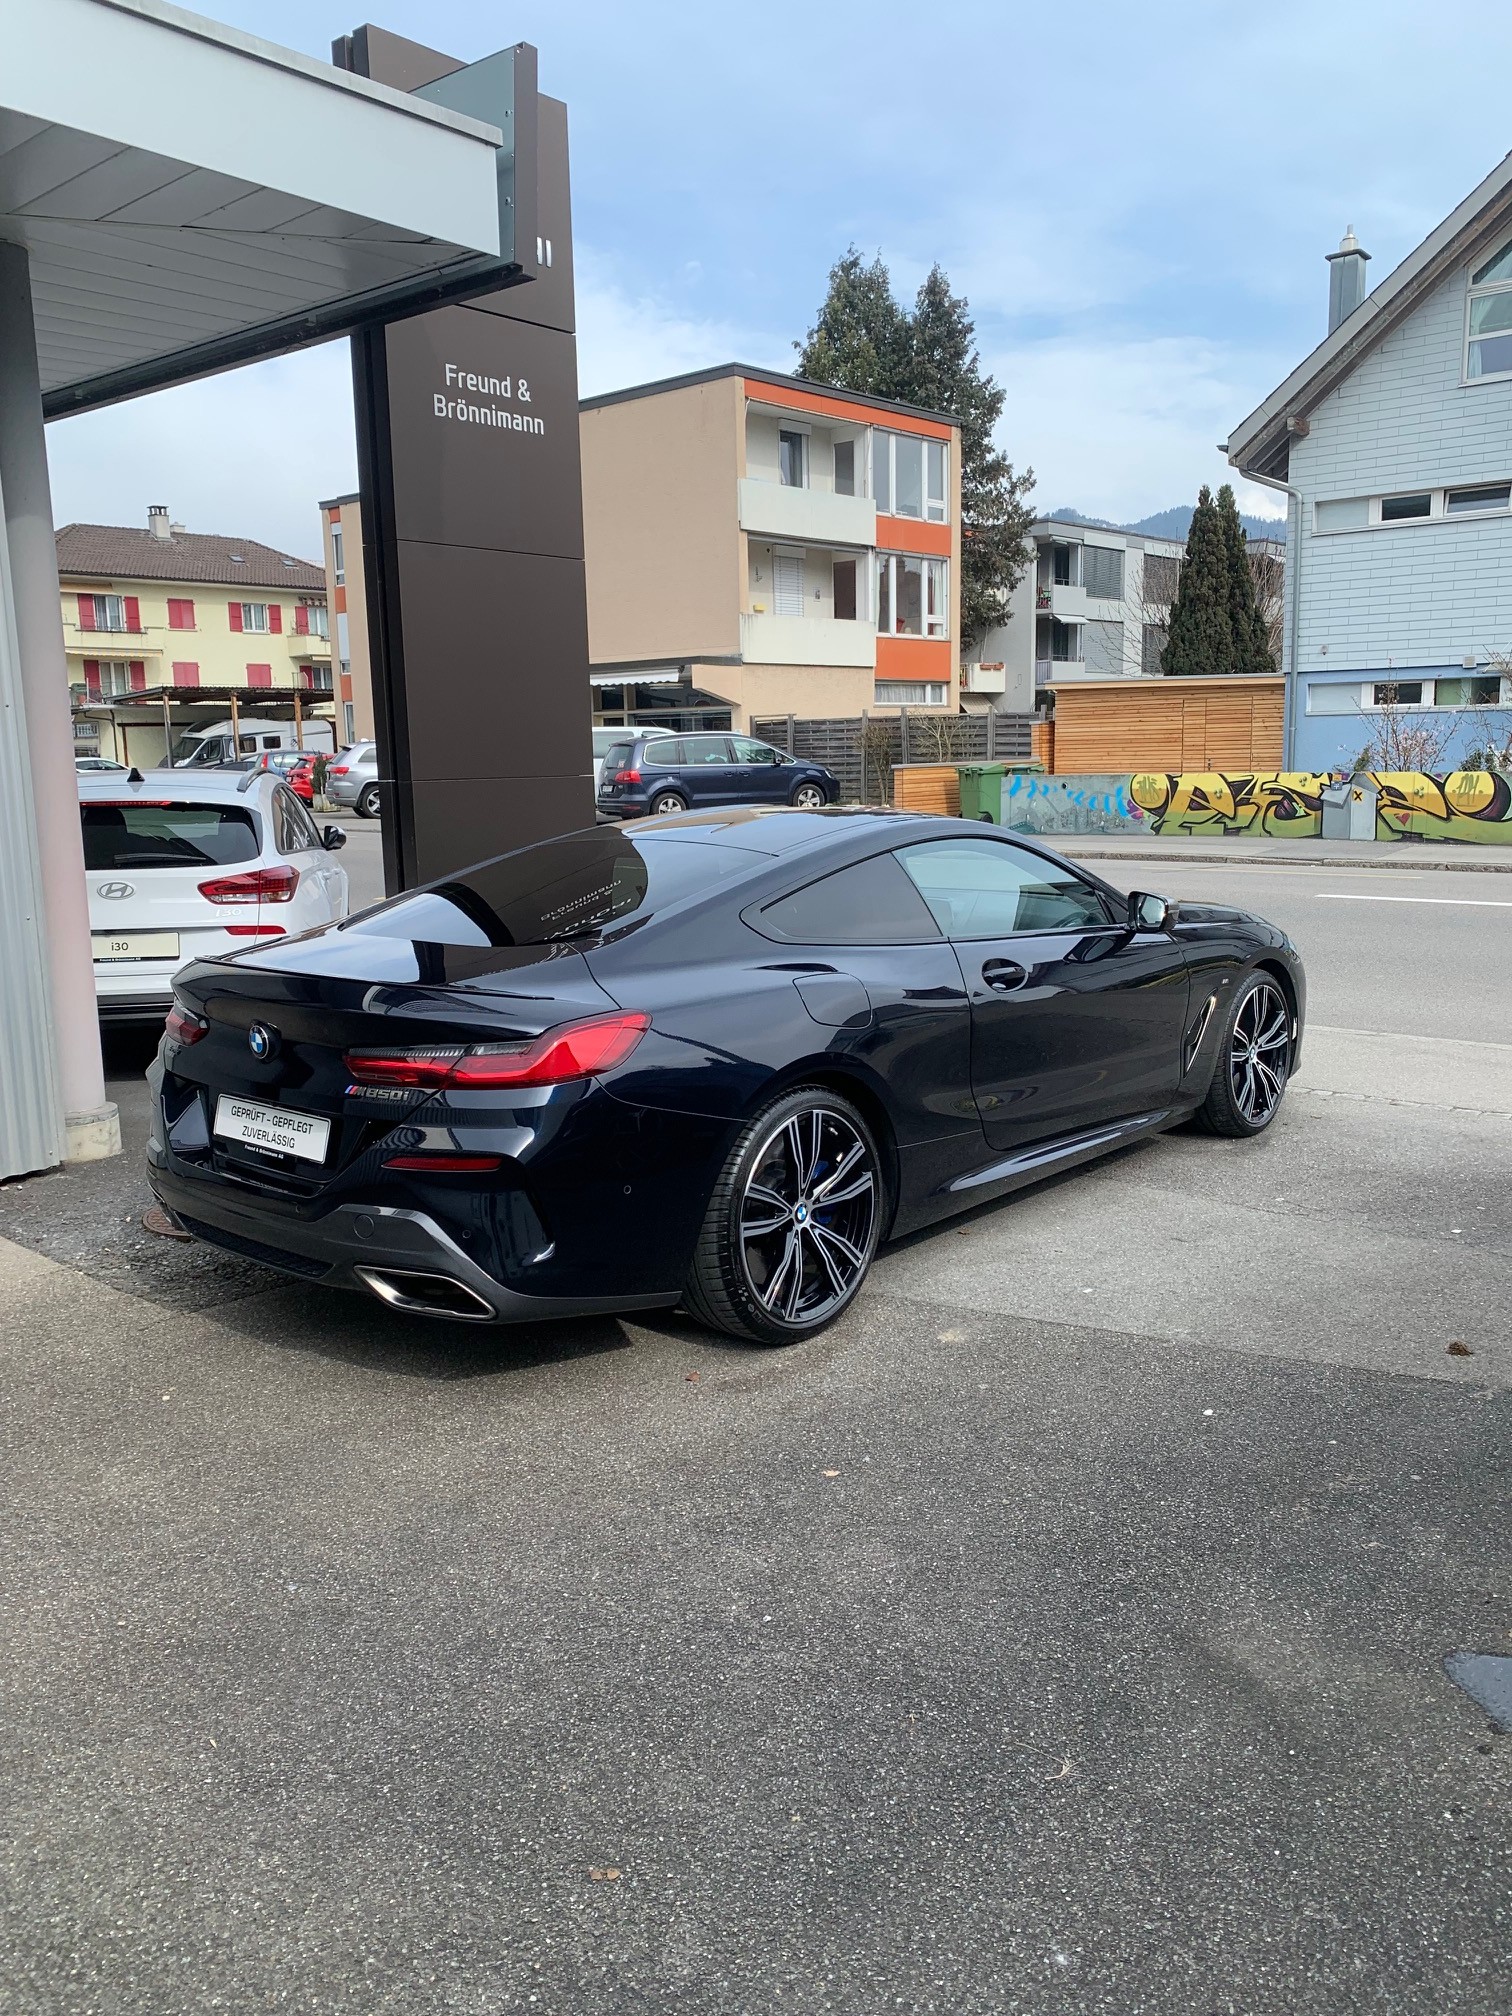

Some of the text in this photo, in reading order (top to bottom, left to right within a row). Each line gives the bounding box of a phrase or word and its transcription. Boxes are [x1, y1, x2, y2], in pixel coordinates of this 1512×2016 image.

[445, 363, 532, 402] Freund &
[433, 393, 545, 435] Brönnimann
[111, 942, 129, 951] i30
[231, 1105, 266, 1123] GEPRÜFT
[272, 1115, 313, 1135] GEPFLEGT
[242, 1125, 295, 1149] ZUVERLÄSSIG
